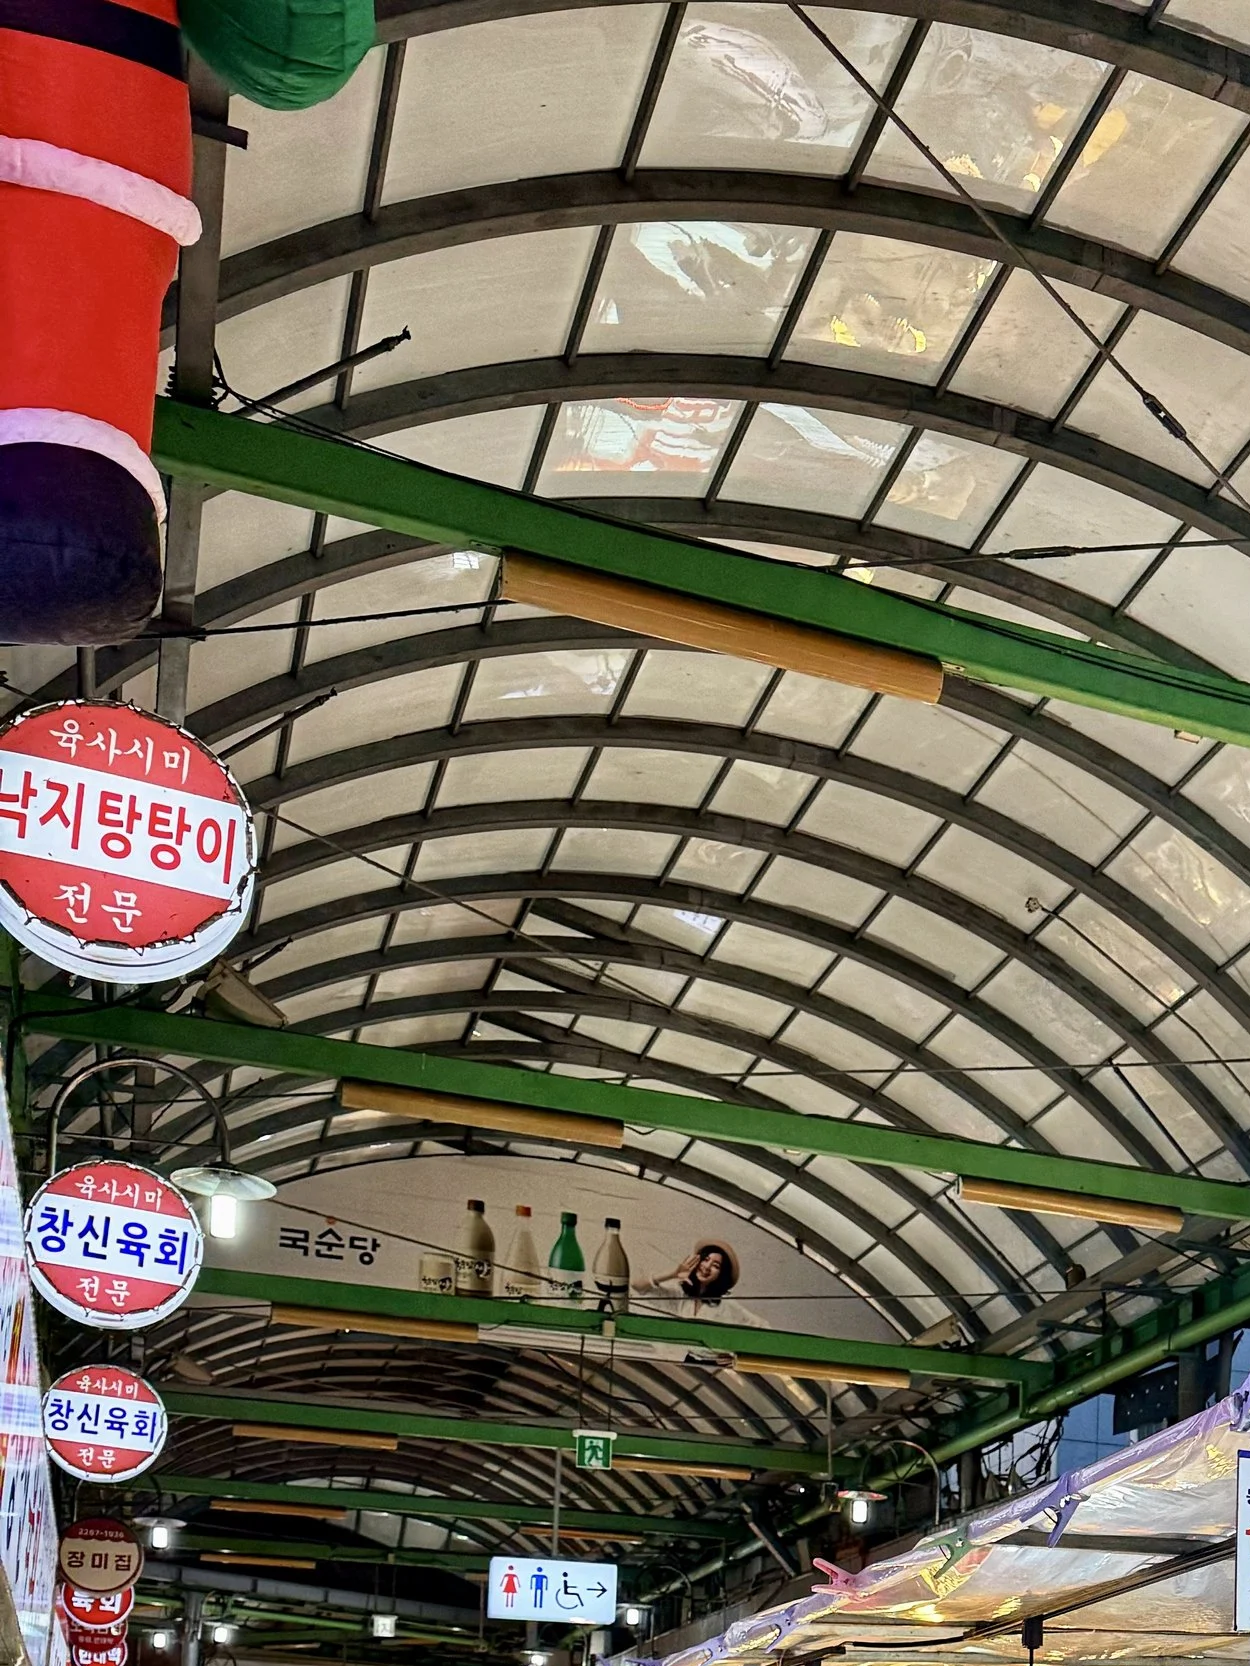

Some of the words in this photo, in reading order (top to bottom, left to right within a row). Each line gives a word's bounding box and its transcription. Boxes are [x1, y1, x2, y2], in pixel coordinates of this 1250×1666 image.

[49, 719, 190, 785] 육사시미
[0, 767, 236, 885] 낙지탕탕이
[53, 881, 144, 933] 전문
[75, 1175, 163, 1211] 육사시미
[37, 1205, 189, 1276] 창신육회
[279, 1219, 382, 1266] 국순당
[76, 1276, 132, 1307] 전문
[76, 1375, 139, 1399] 육사시미
[47, 1398, 158, 1443] 창신육회
[77, 1448, 117, 1469] 전문
[67, 1551, 132, 1572] 장미집
